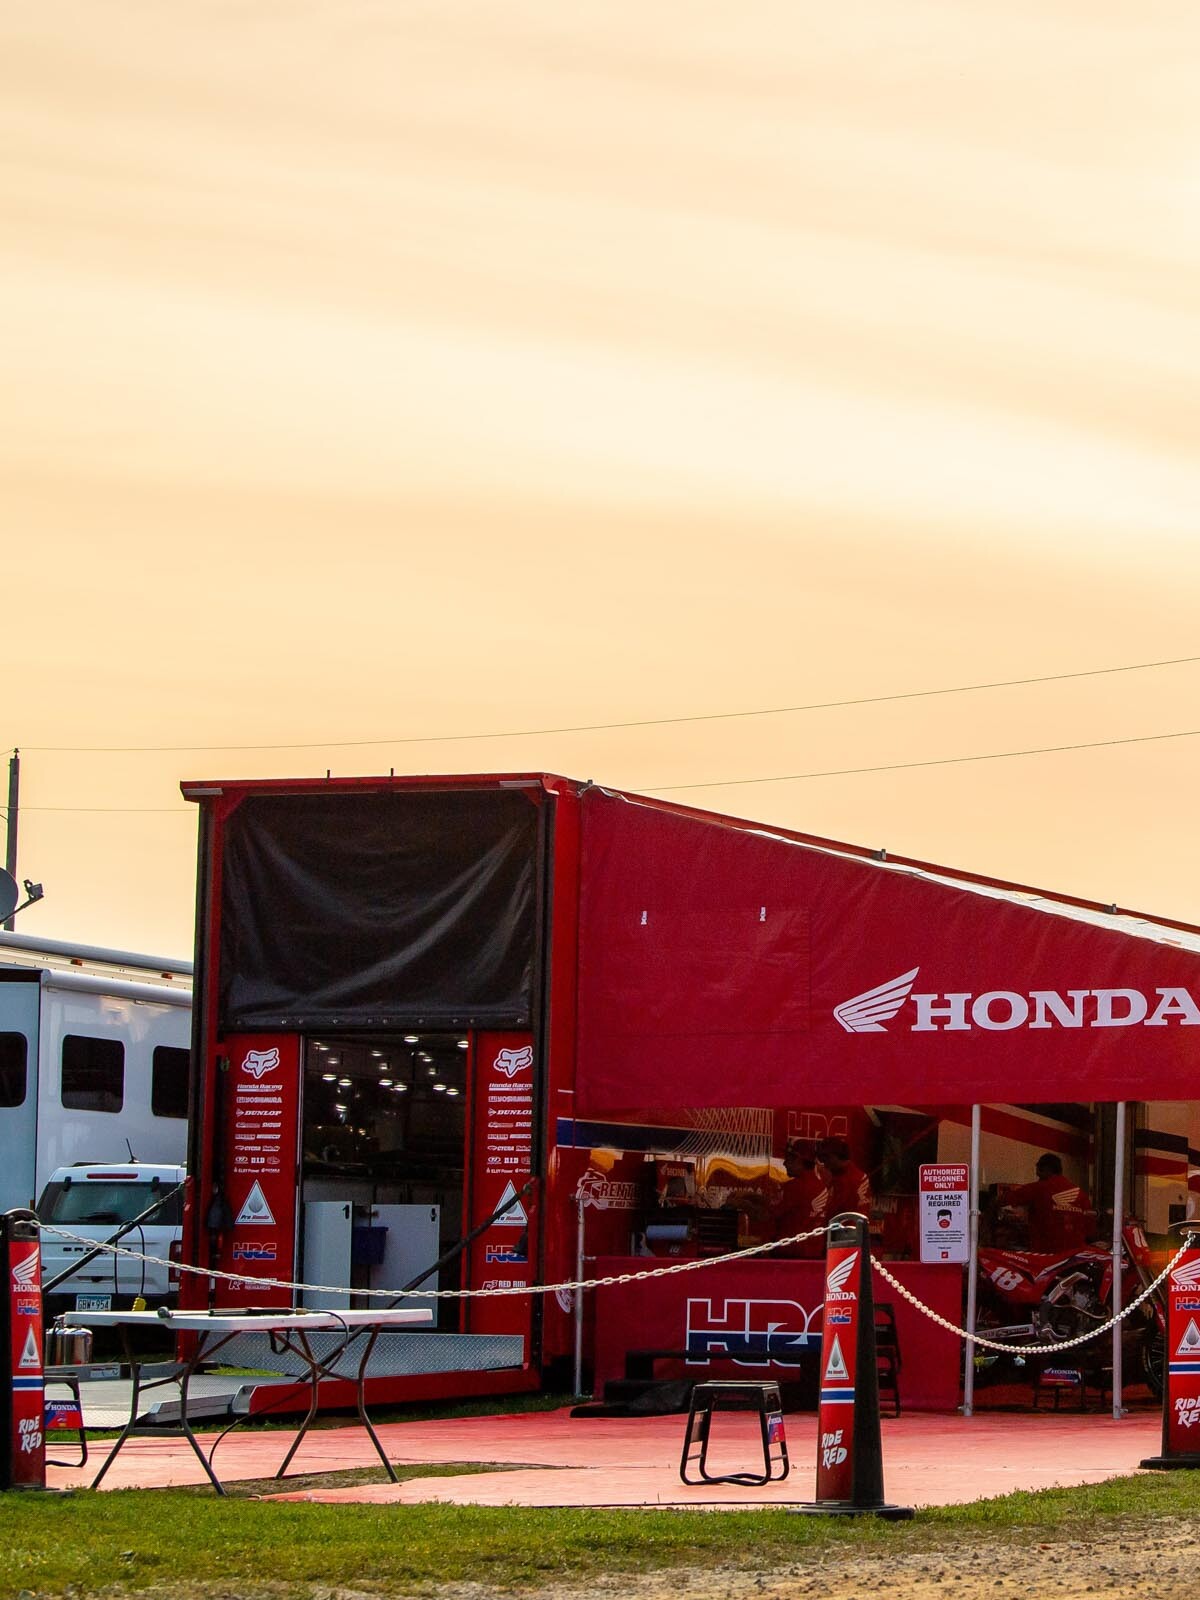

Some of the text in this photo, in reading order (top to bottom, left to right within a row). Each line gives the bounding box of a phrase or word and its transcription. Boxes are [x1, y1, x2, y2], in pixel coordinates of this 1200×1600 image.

[923, 1168, 966, 1176] AUTHORIZED
[232, 1242, 277, 1261] HRC
[991, 1266, 1024, 1291] 18
[826, 1291, 857, 1302] HONDA
[17, 1299, 40, 1315] HRC
[827, 1307, 852, 1325] HRC
[51, 1403, 78, 1411] HONDA
[18, 1415, 40, 1434] RIDE
[20, 1432, 42, 1454] RED
[821, 1429, 844, 1449] RIDE
[822, 1446, 848, 1470] RED
